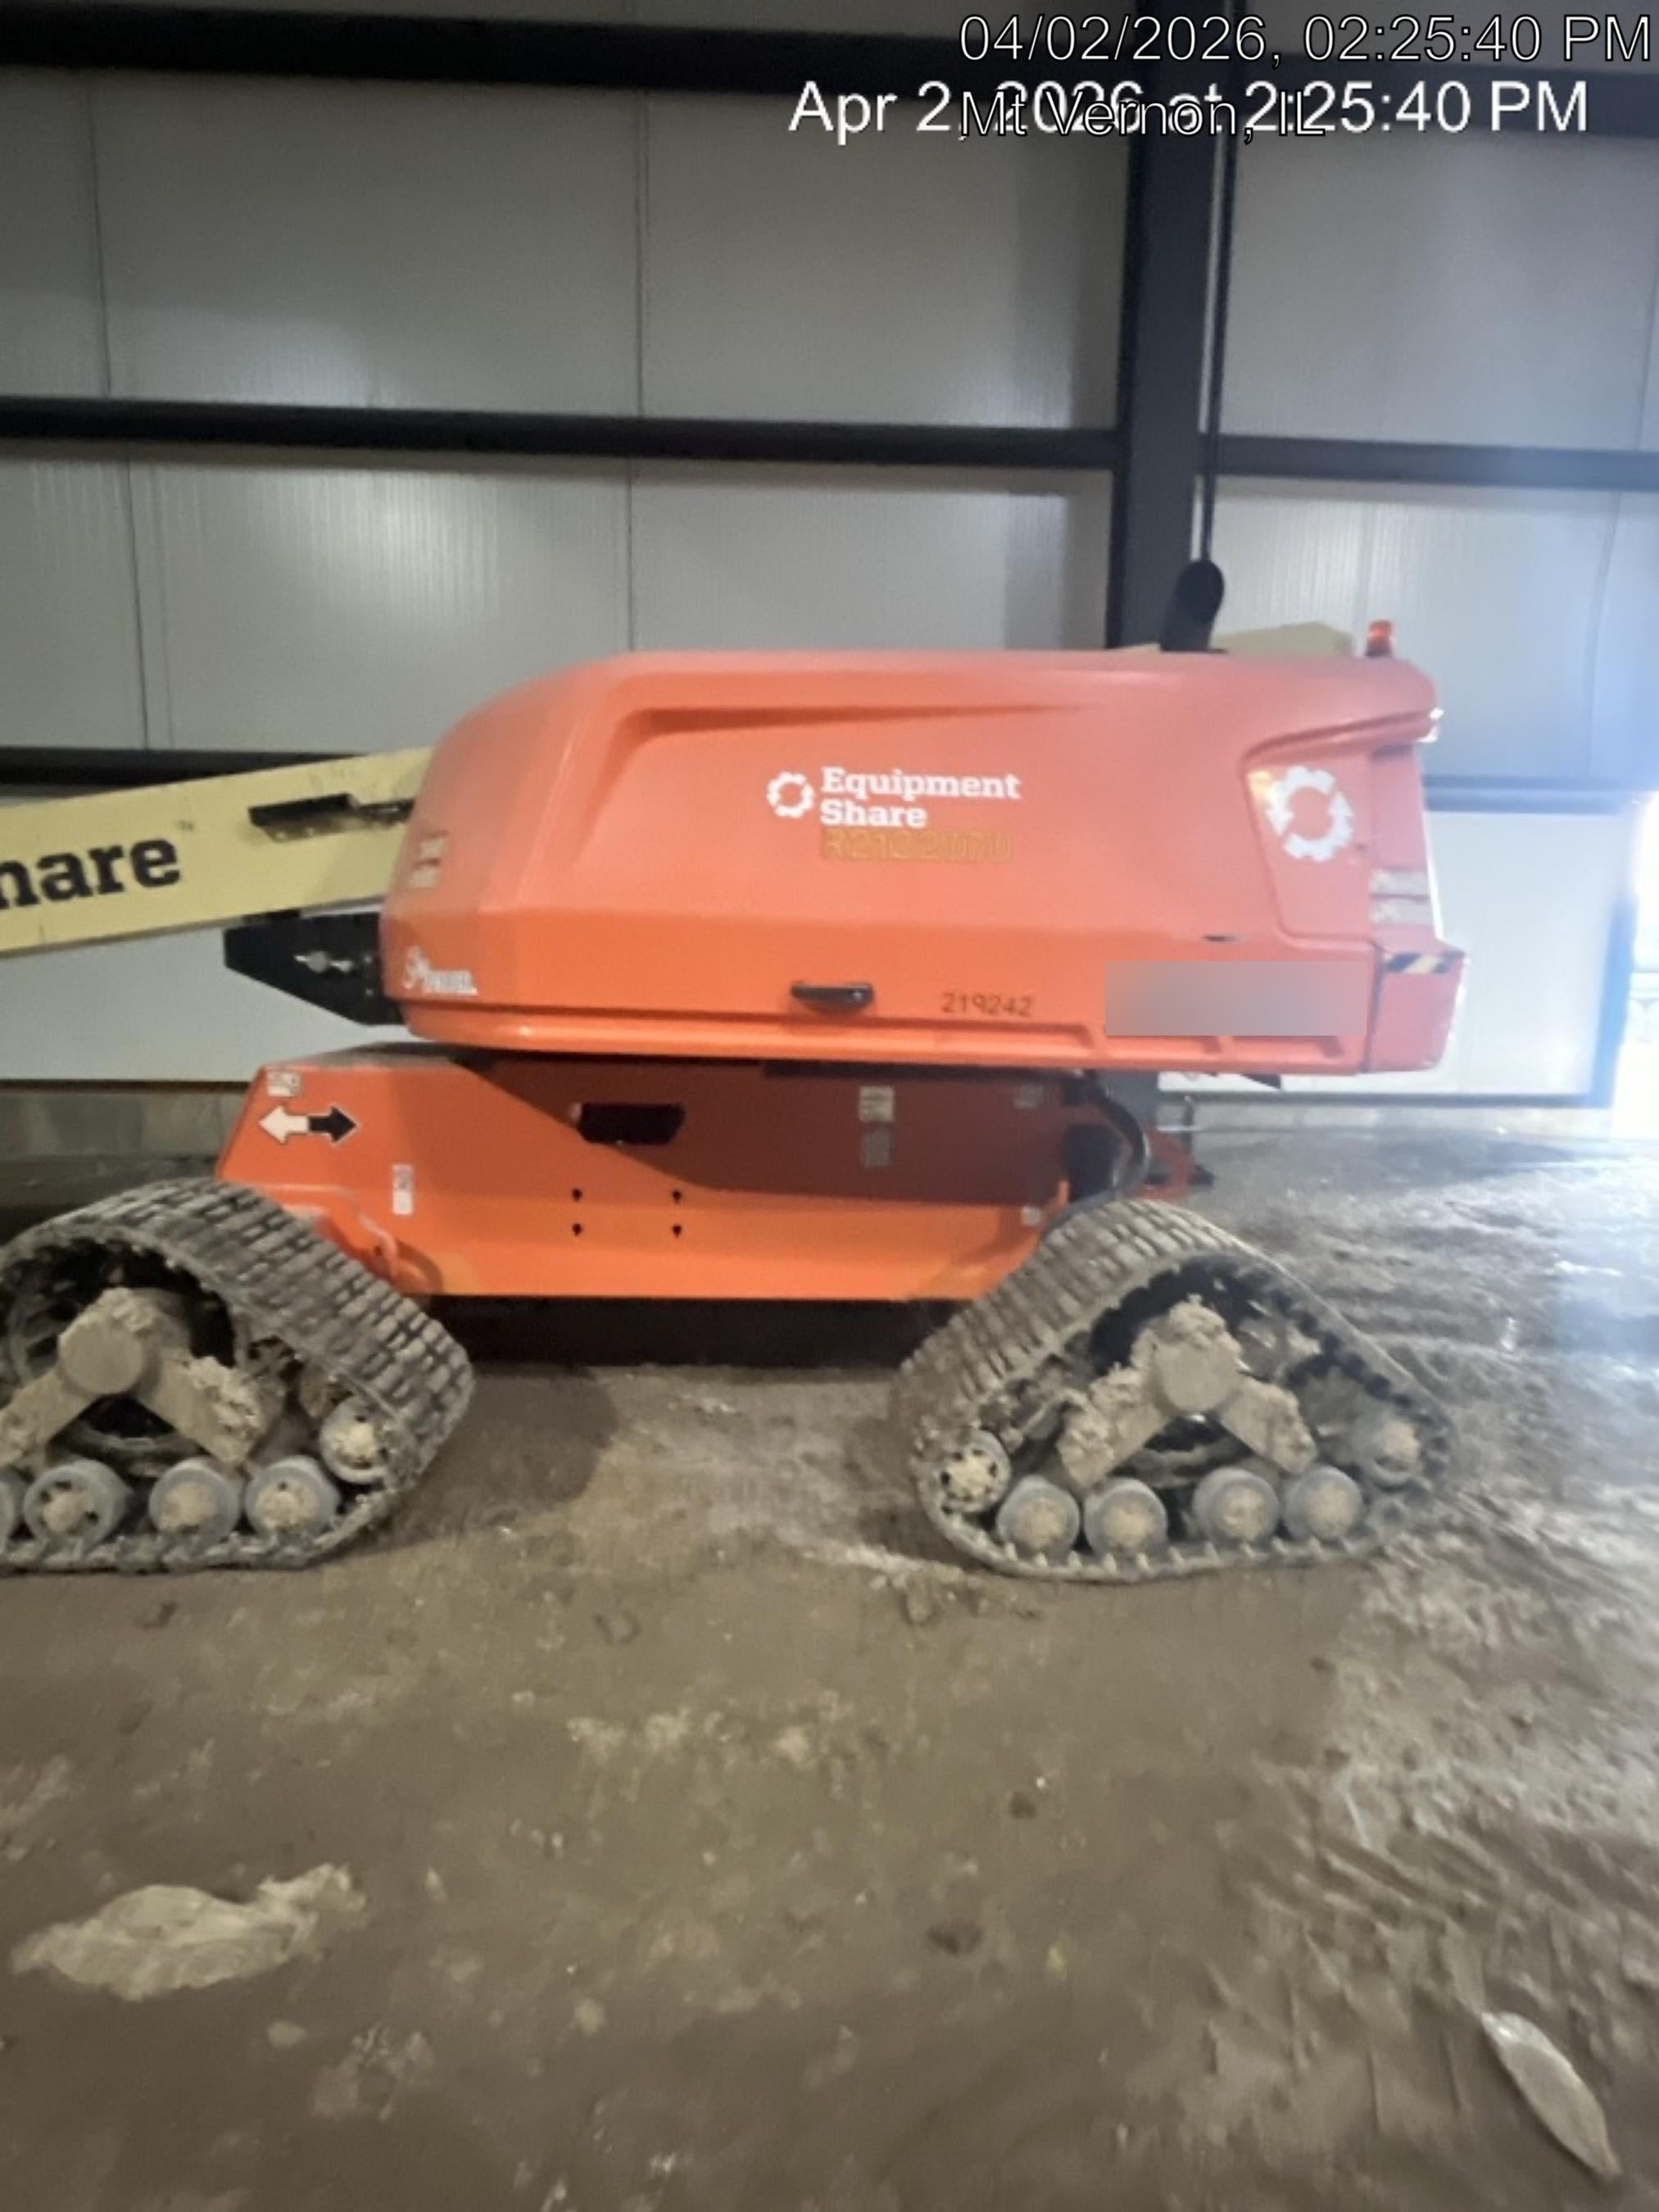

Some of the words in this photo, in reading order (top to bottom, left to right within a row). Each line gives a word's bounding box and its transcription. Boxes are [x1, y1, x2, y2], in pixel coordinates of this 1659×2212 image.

[821, 766, 1022, 800] Equipment
[819, 799, 927, 828] Share
[941, 991, 1036, 1018] 219242
